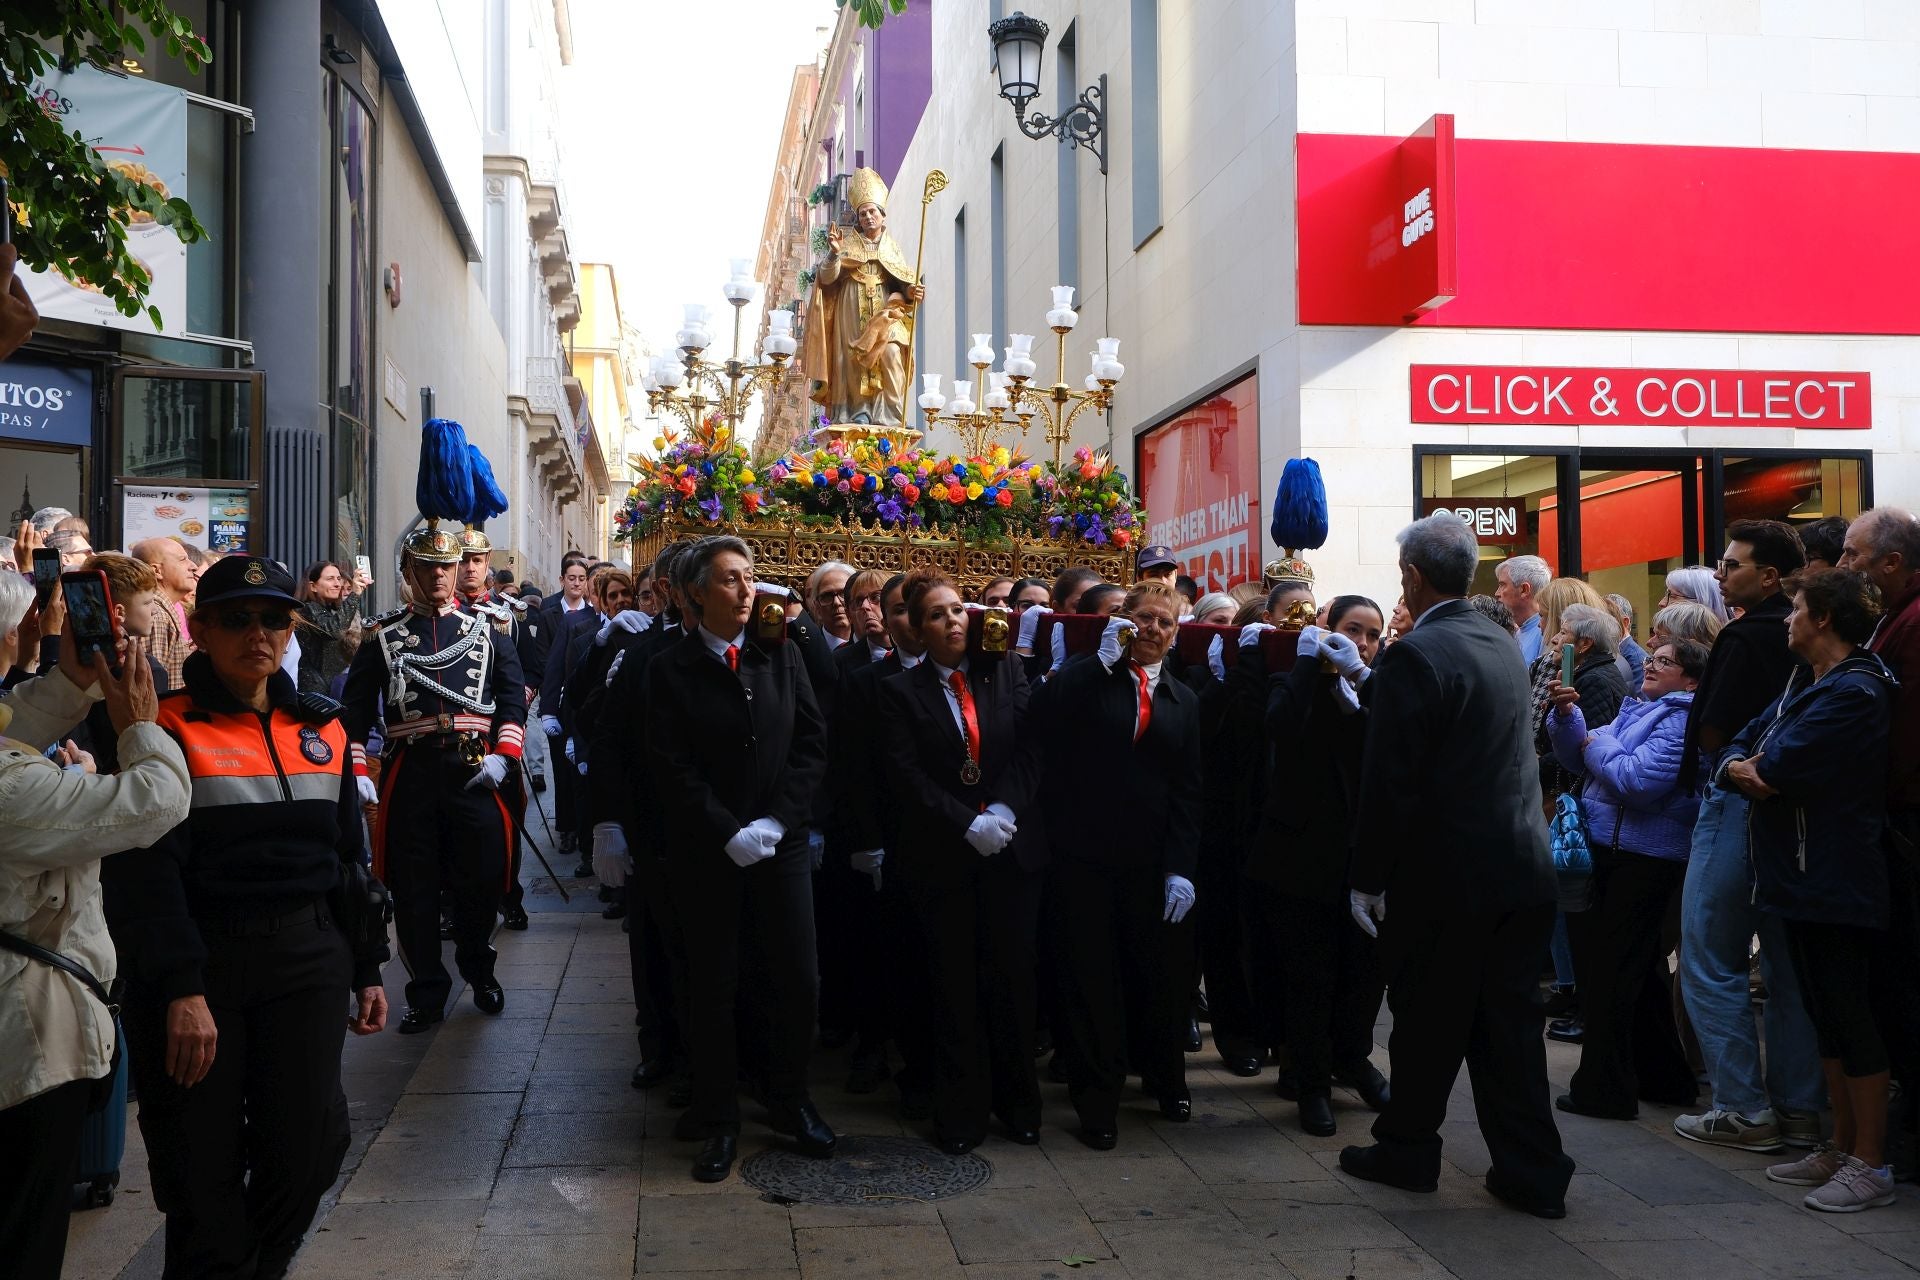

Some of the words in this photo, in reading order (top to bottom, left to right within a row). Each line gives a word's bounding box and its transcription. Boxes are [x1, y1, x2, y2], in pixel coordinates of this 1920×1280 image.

[1404, 187, 1432, 224] FIVE
[1402, 210, 1435, 248] GUYS
[1428, 374, 1574, 416] CLICK
[1588, 376, 1619, 417] &
[1635, 377, 1856, 421] COLLECT
[1151, 508, 1207, 548] FRESHER
[1209, 491, 1249, 534] THAN
[215, 759, 243, 768] CIVIL
